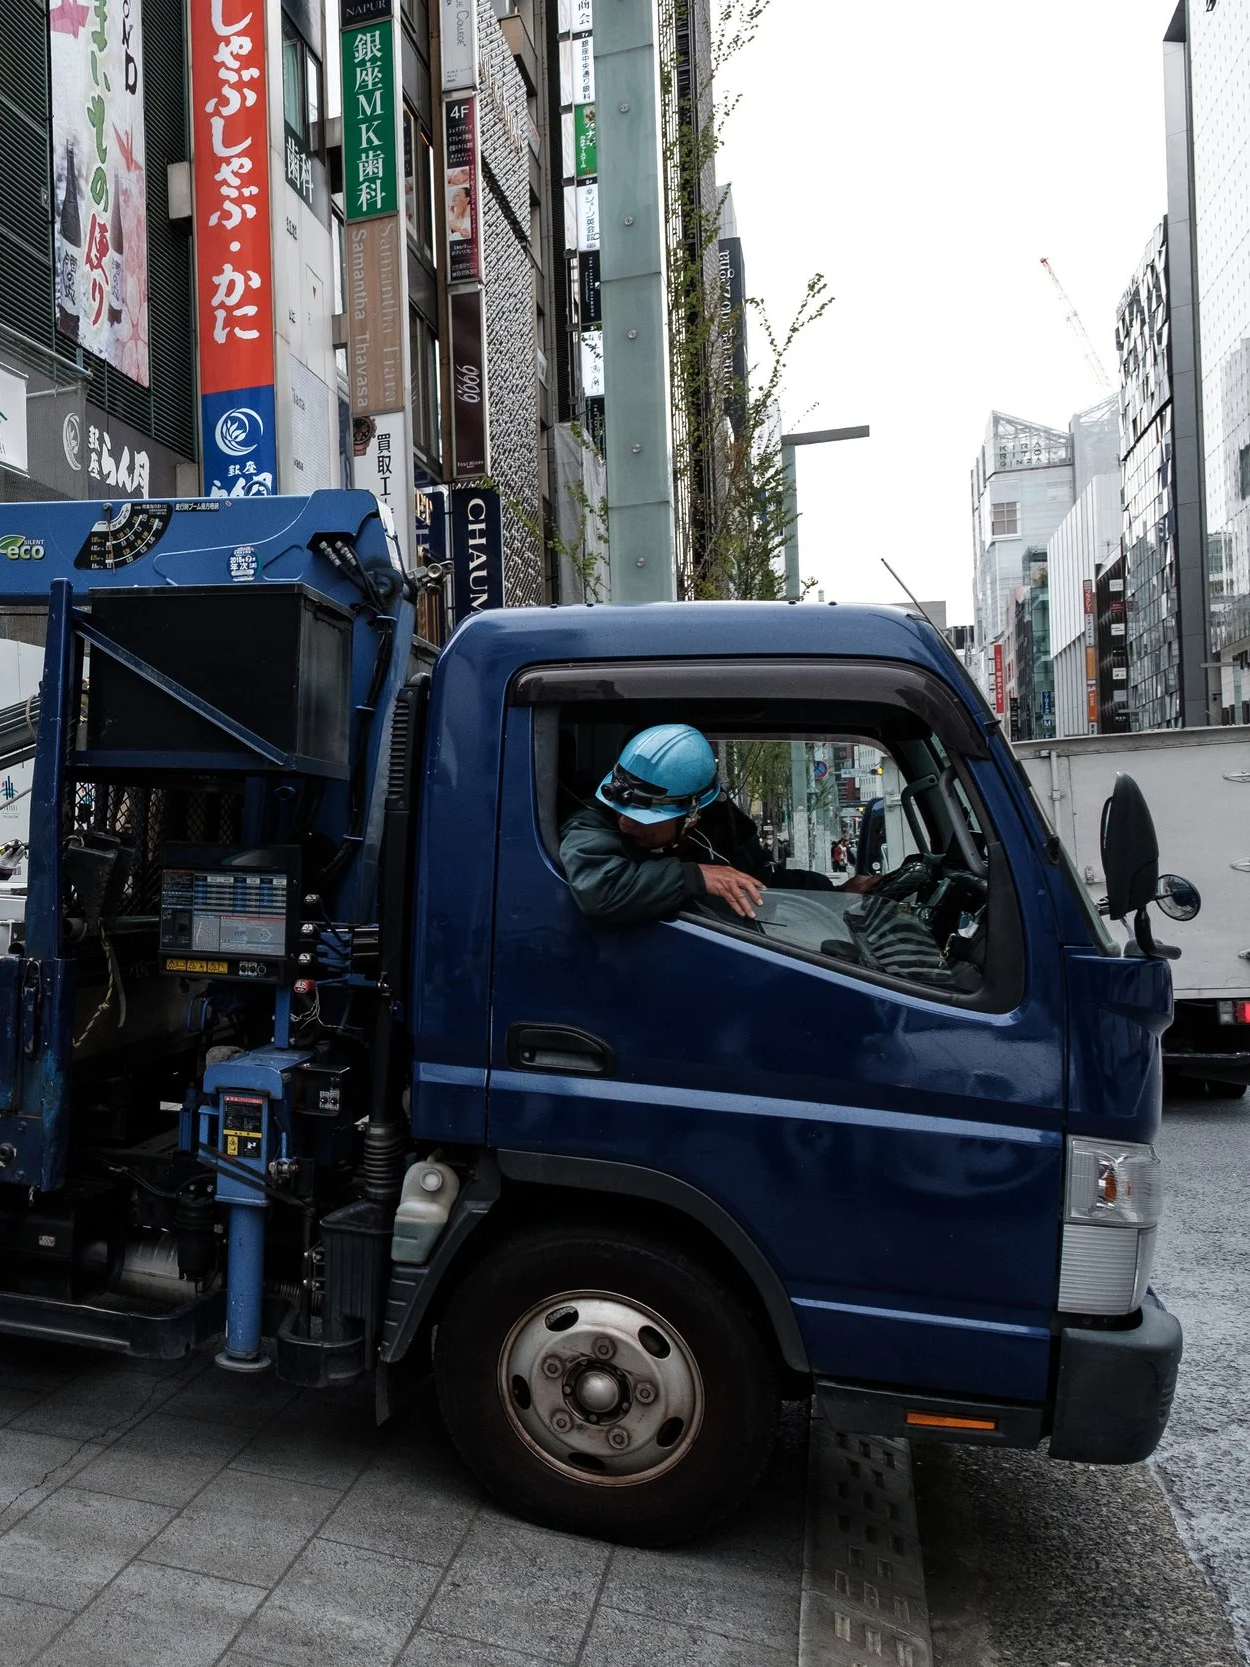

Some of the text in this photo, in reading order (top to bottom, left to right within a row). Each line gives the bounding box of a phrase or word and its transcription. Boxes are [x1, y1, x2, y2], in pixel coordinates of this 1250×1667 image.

[353, 30, 386, 212] 銀座MK歯科
[450, 105, 469, 119] 4F
[285, 136, 314, 203] 歯科
[352, 228, 370, 408] Samantha Thavasa
[380, 222, 399, 402] Samantha Tiara
[228, 461, 257, 477] 銀座
[377, 433, 393, 504] 買取工
[7, 544, 44, 560] eco
